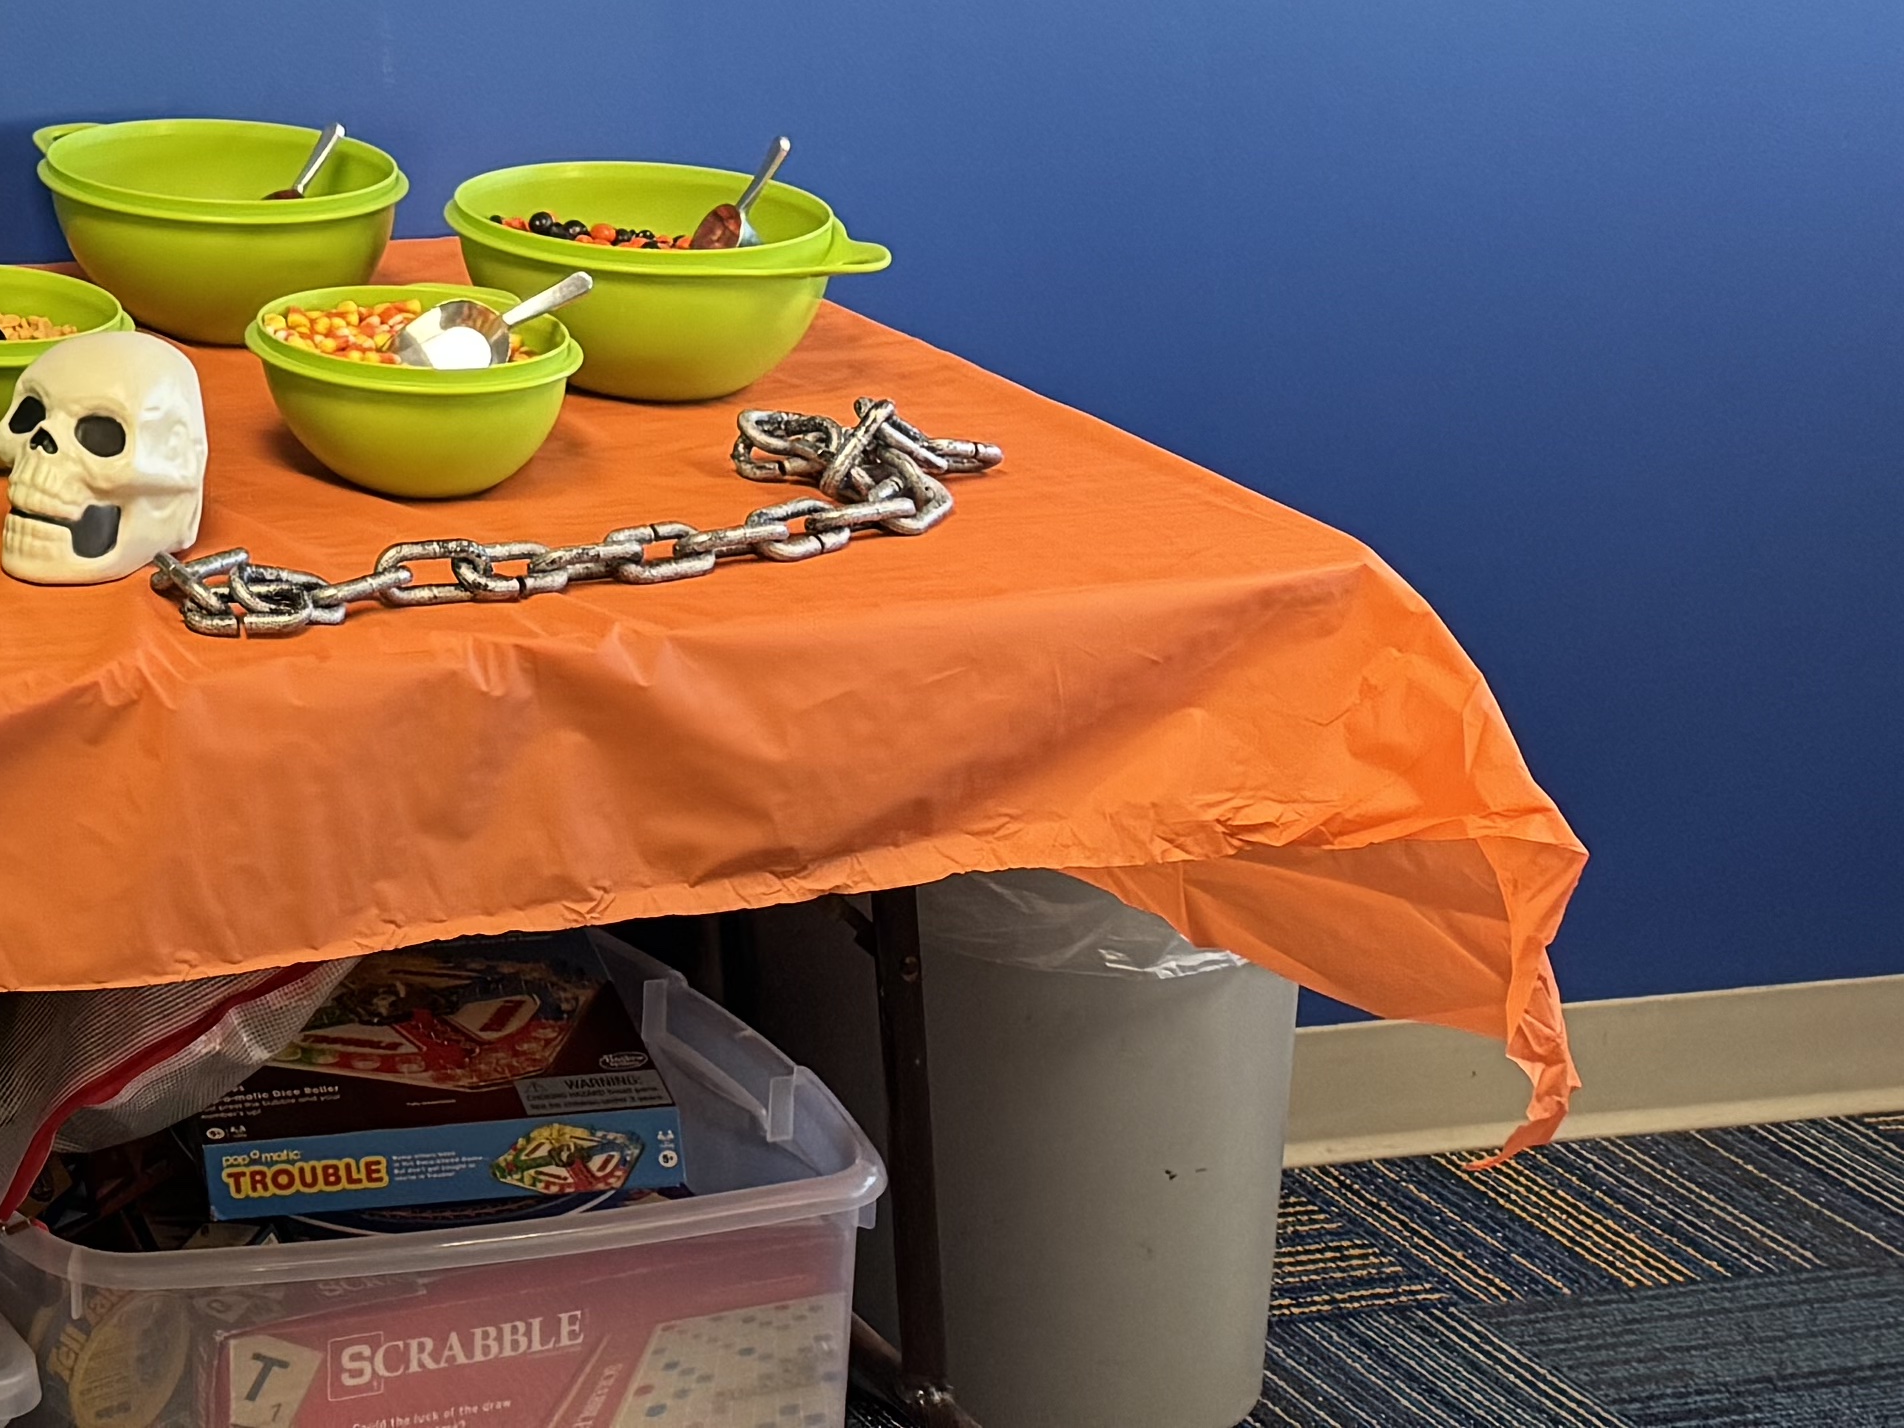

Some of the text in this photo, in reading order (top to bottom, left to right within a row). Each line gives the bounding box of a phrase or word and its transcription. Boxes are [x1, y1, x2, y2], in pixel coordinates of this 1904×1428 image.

[260, 1148, 301, 1161] matic
[225, 1158, 385, 1196] TROUBLE
[340, 1310, 584, 1386] SCRABBLE
[245, 1352, 289, 1402] T
[459, 1404, 478, 1416] the
[482, 1399, 512, 1412] draw
